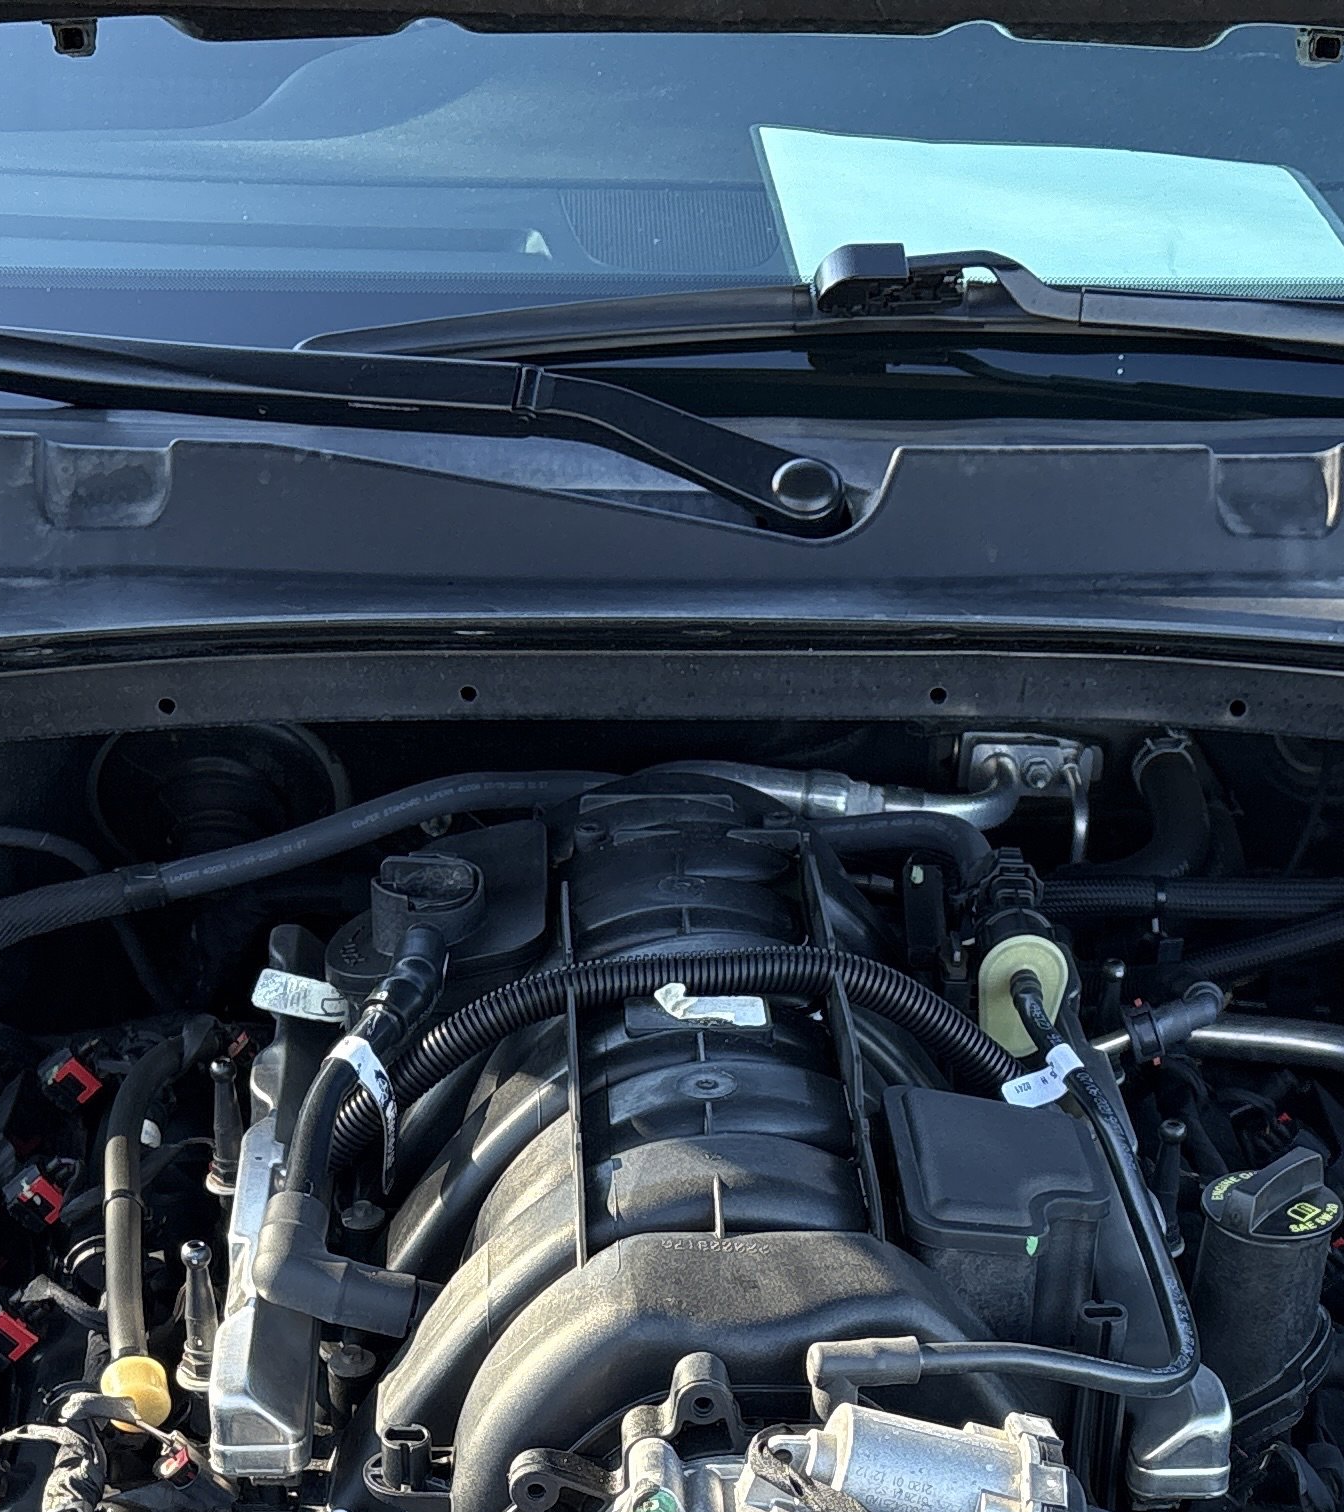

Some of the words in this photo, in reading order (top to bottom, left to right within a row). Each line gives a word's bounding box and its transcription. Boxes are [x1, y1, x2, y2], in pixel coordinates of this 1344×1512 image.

[1210, 1174, 1242, 1201] ENGINE
[1288, 1220, 1318, 1233] SAE
[1314, 1202, 1340, 1227] 5W-20
